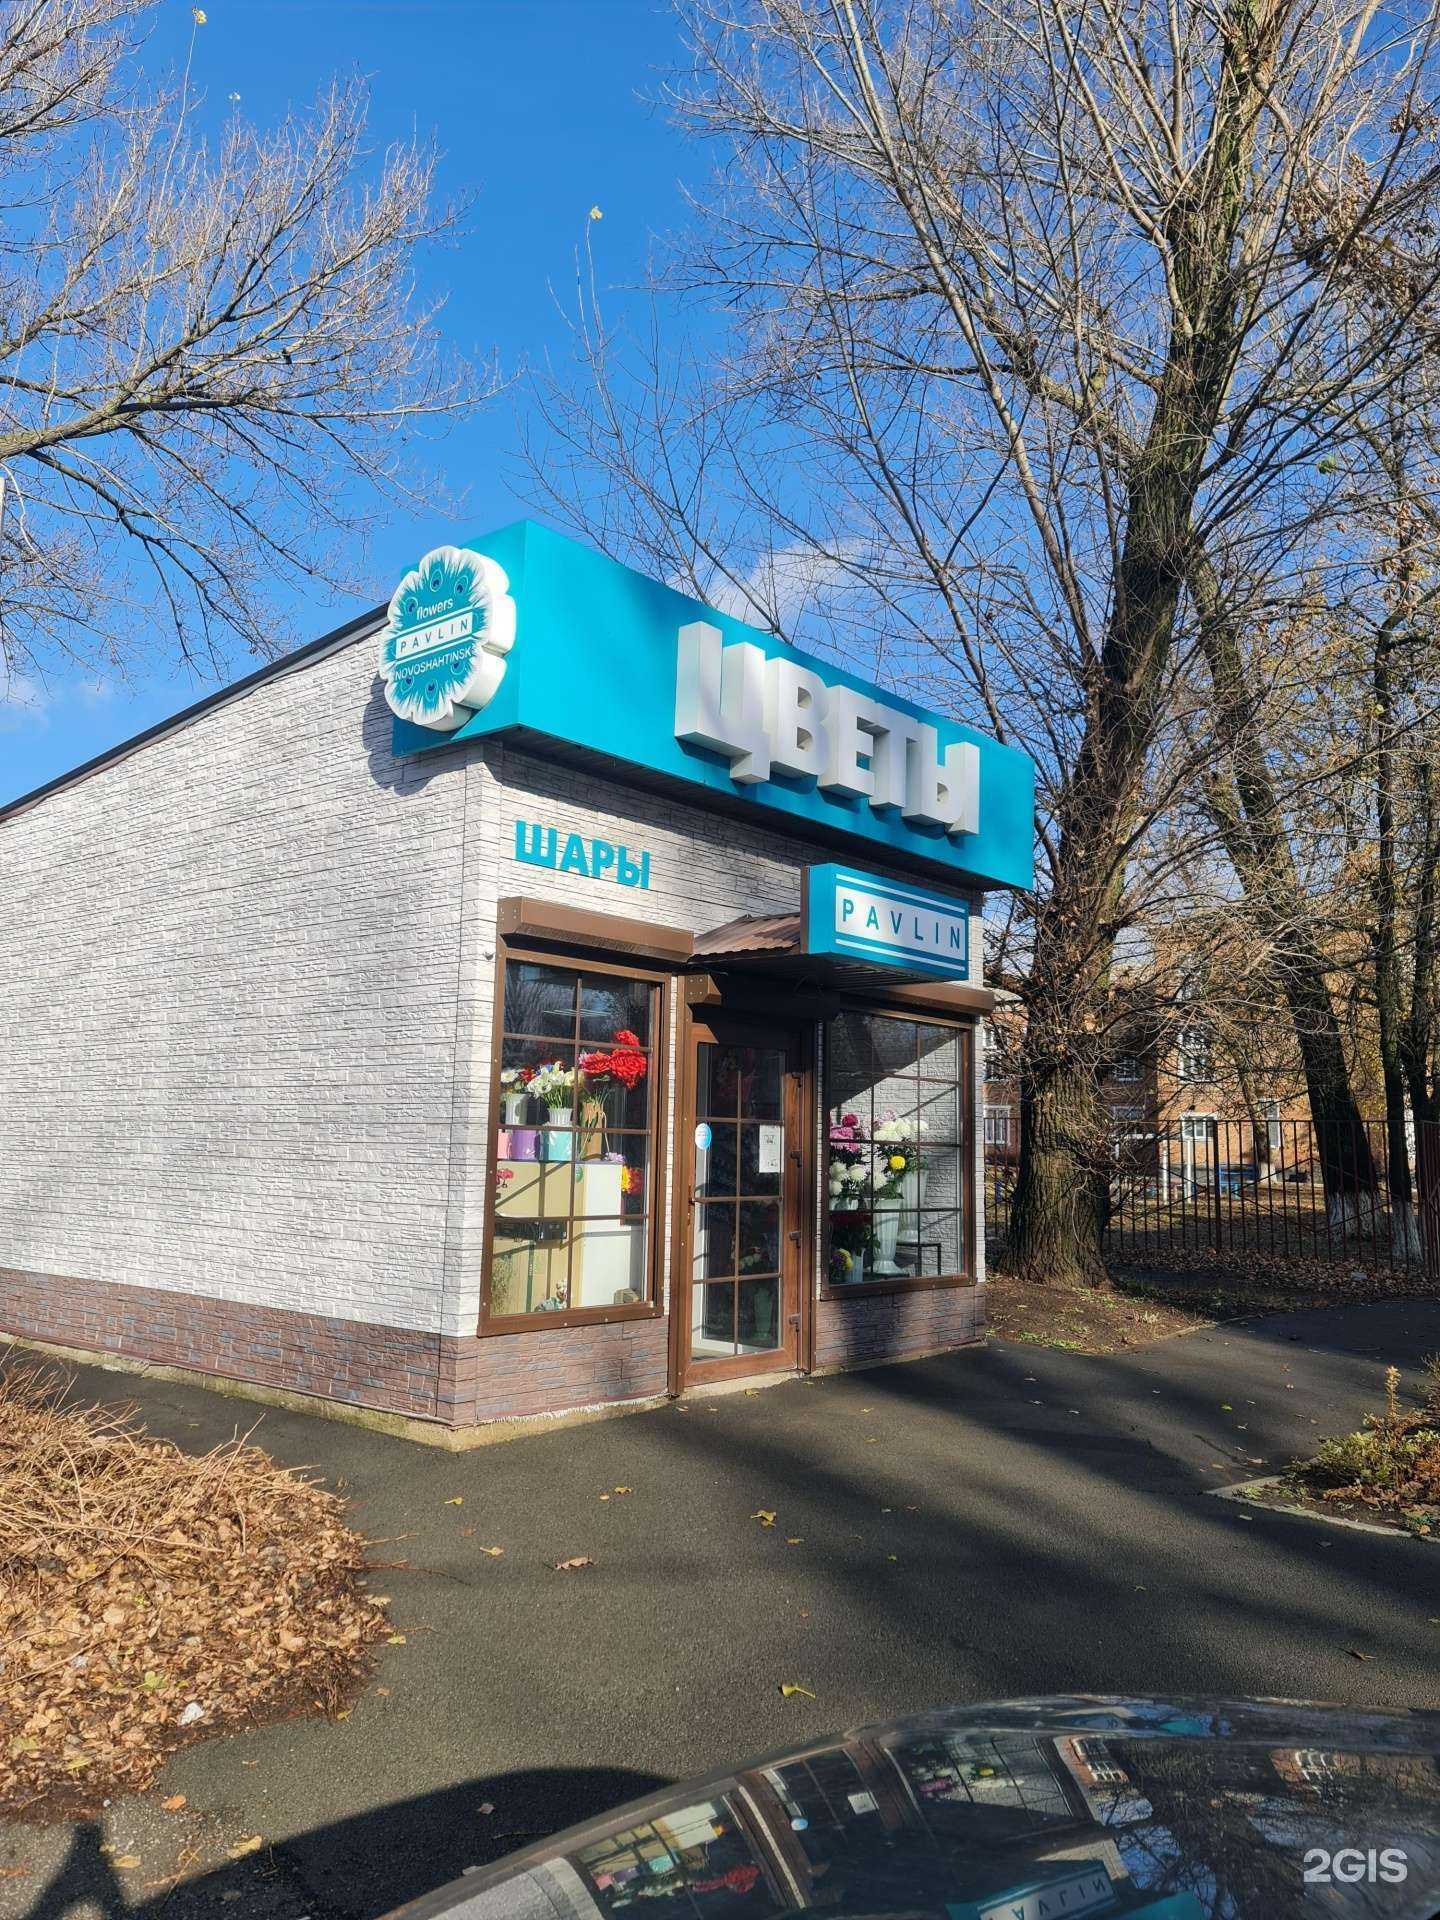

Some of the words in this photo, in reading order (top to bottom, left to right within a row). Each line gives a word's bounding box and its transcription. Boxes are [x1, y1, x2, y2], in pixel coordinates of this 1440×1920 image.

[416, 598, 454, 621] flowers
[400, 619, 468, 652] PAVLIN
[395, 645, 472, 680] NOVOSHAHTINSK
[674, 621, 980, 836] ЦВЕТЫ
[515, 820, 651, 889] ШАРЫ
[842, 898, 961, 950] PAVLIN
